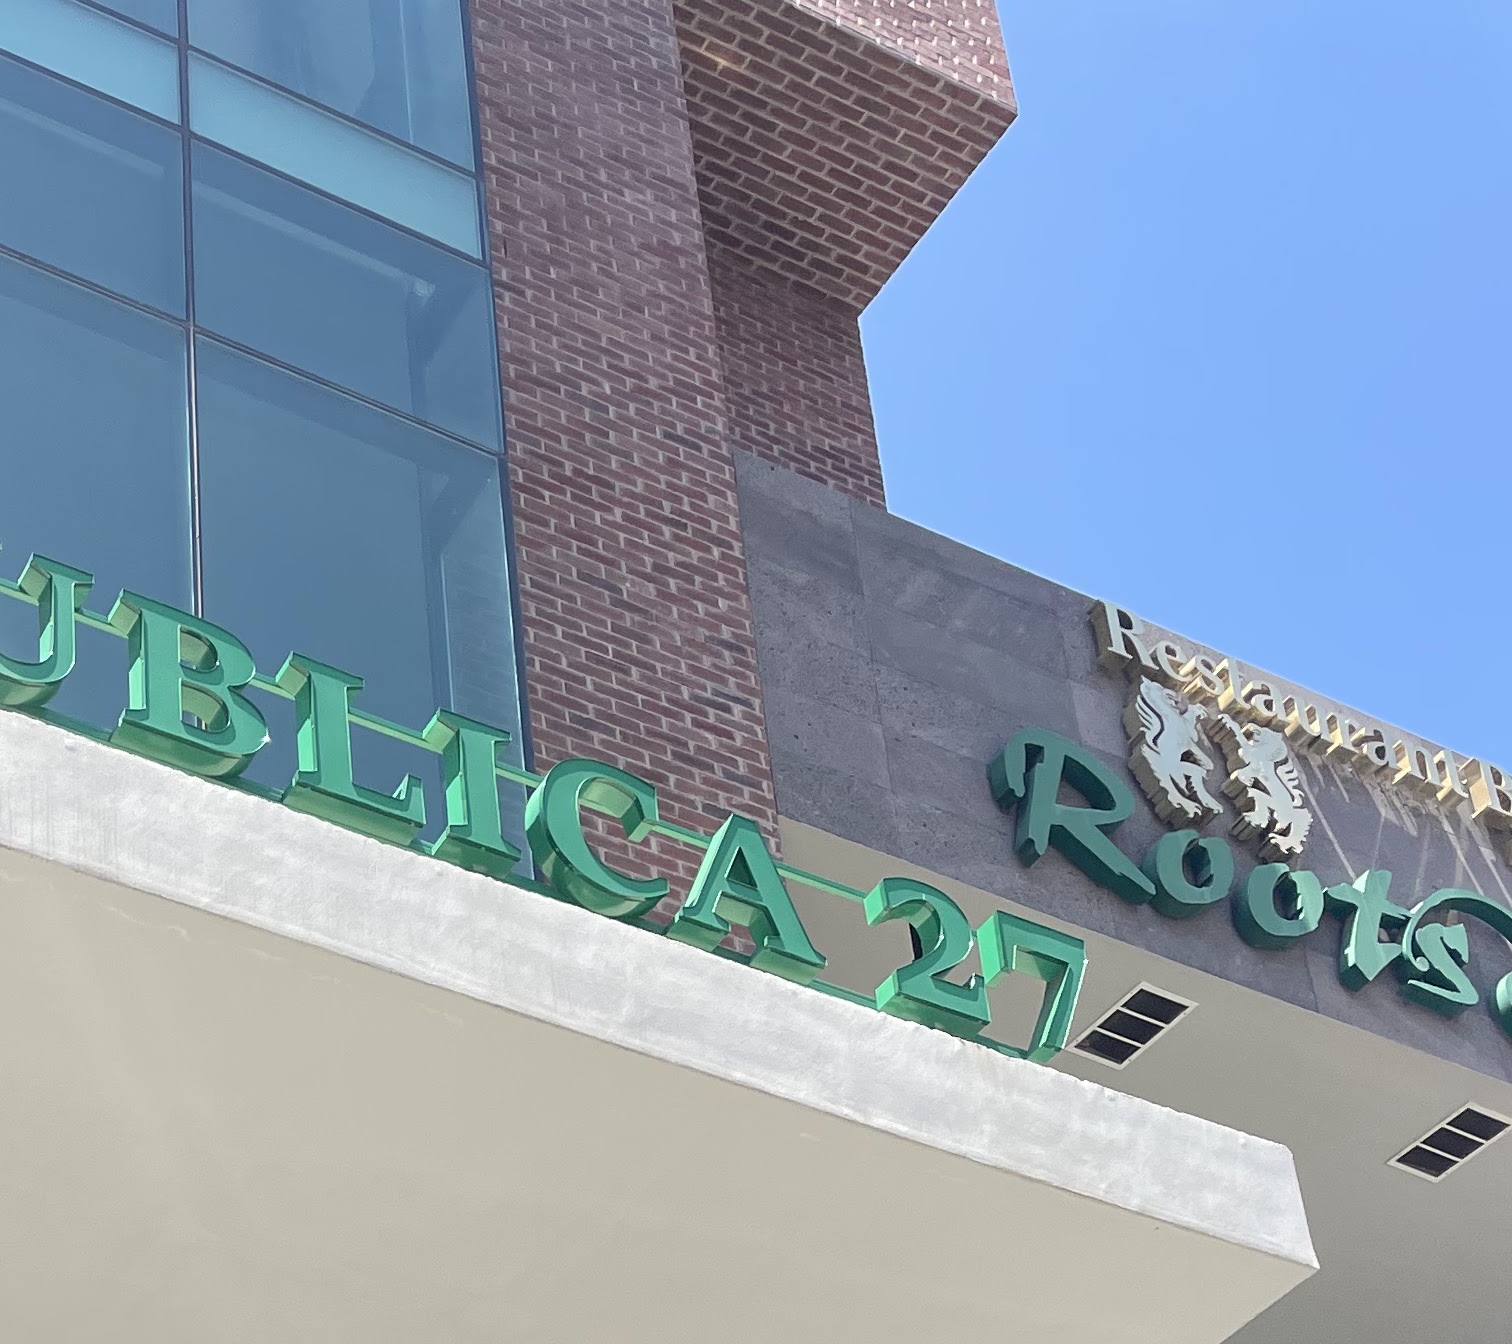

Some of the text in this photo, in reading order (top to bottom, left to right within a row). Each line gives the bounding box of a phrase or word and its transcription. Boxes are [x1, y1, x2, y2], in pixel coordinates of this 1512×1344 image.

[1088, 599, 1470, 806] Restaurant
[864, 877, 1088, 1063] 27
[989, 727, 1512, 1018] Roots
